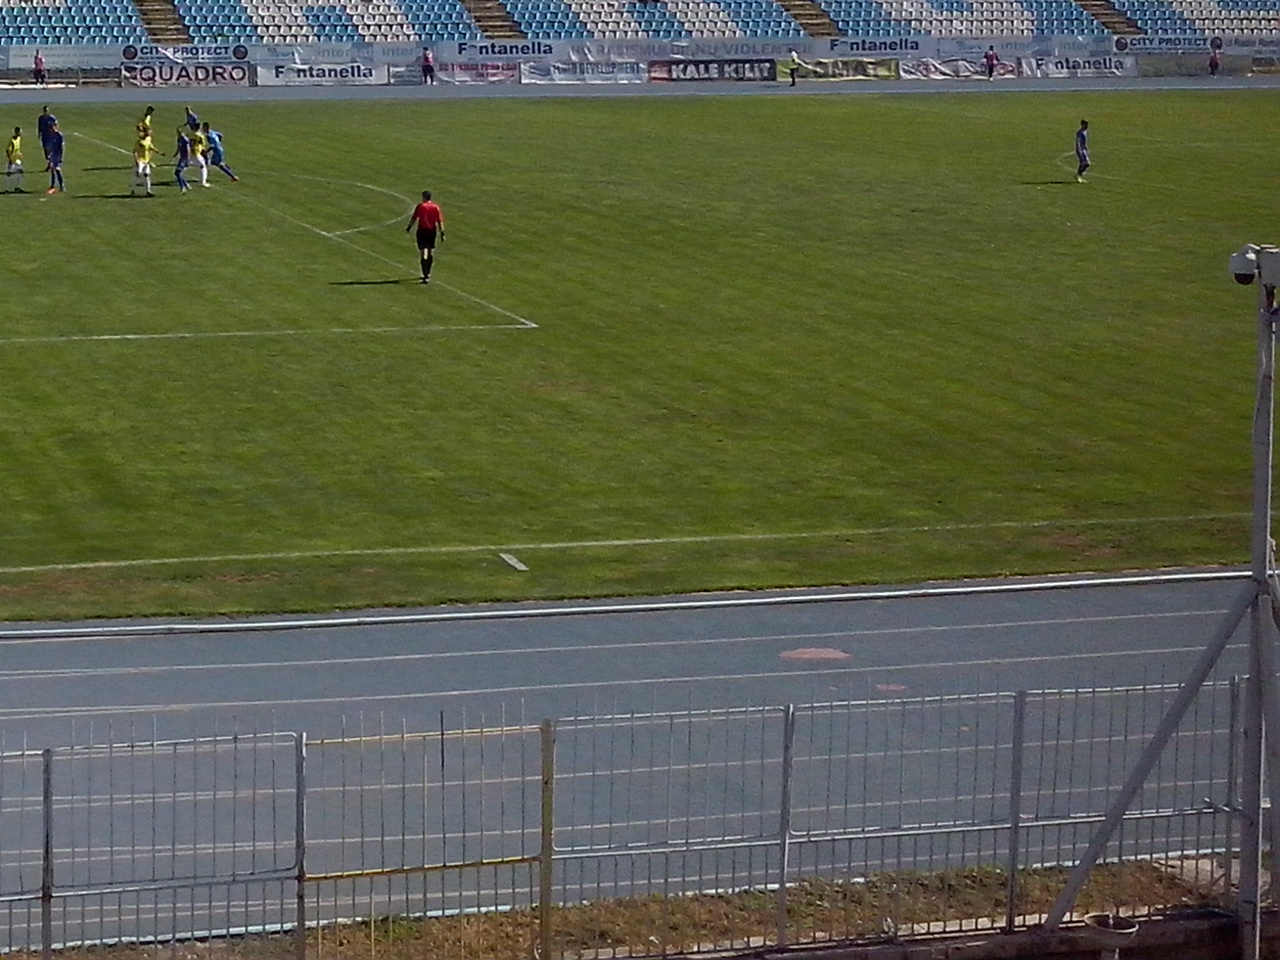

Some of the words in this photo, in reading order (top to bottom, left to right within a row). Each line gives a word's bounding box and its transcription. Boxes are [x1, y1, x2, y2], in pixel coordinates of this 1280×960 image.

[1130, 38, 1155, 47] CITY
[1159, 38, 1208, 47] PROTECT
[172, 46, 230, 57] PROTECT
[122, 65, 247, 82] QUADRO
[672, 63, 718, 79] KALE
